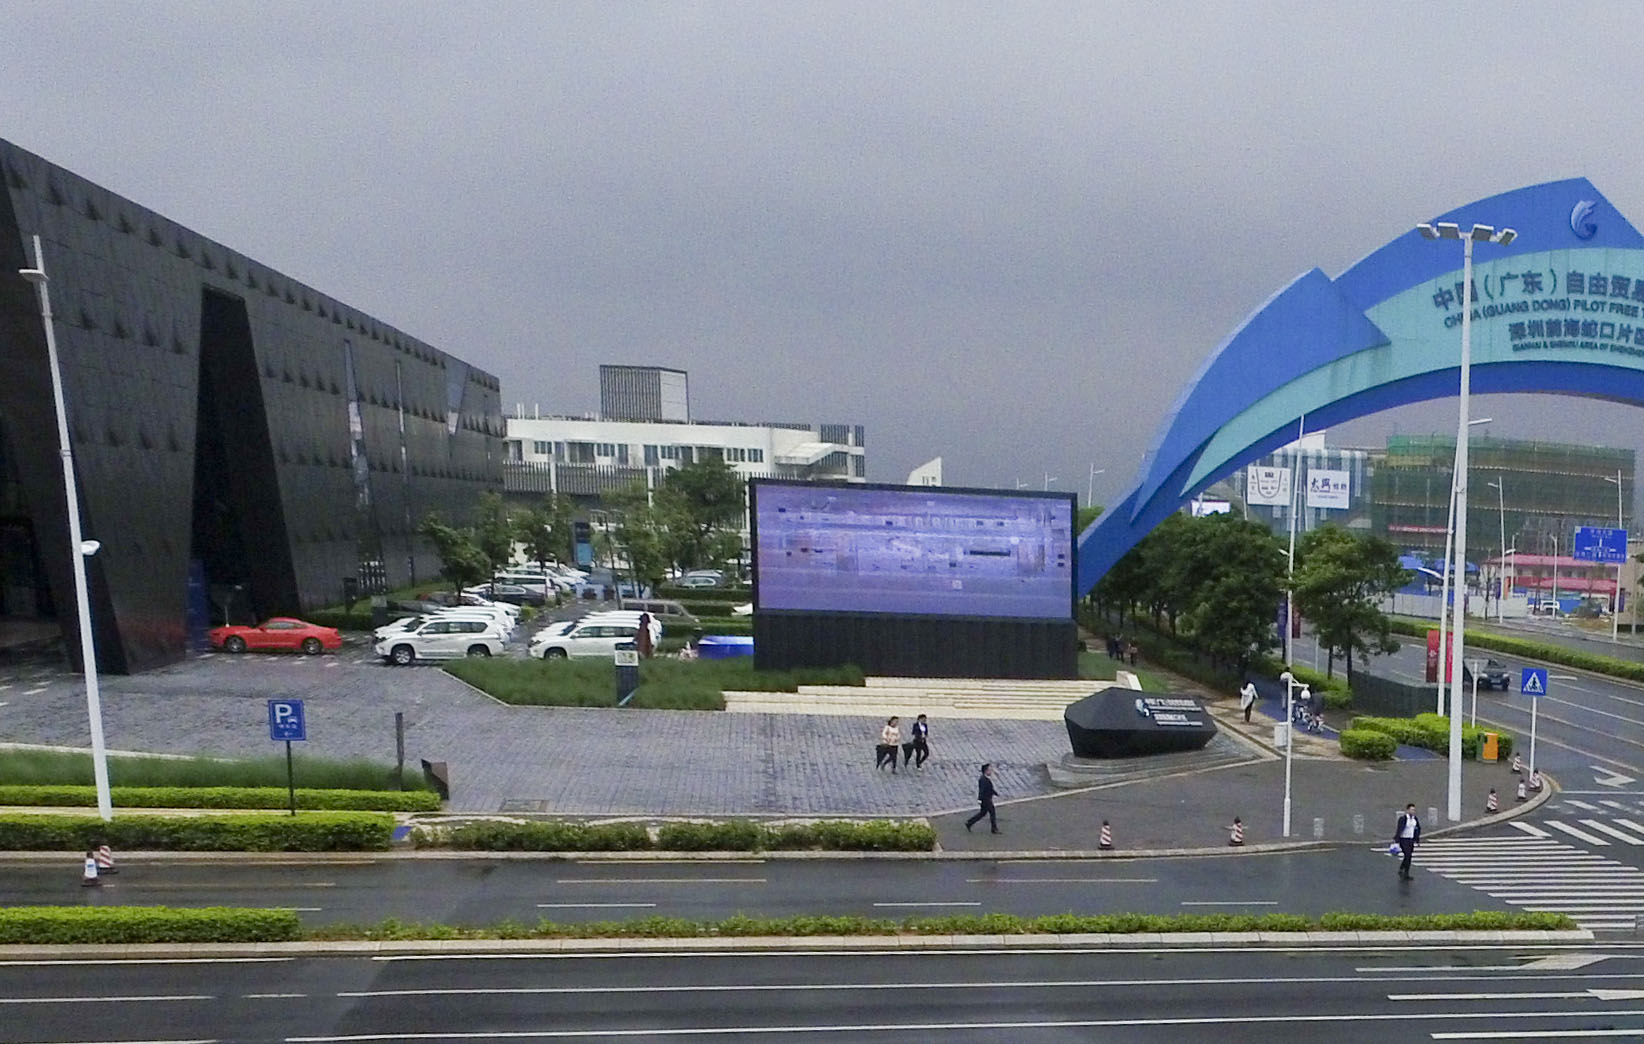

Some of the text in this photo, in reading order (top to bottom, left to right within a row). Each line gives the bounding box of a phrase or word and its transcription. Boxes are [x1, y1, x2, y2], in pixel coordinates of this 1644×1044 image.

[1444, 308, 1482, 329] CHIA
[1573, 299, 1607, 313] PILOT
[1608, 302, 1639, 318] FREE
[274, 703, 293, 724] P
